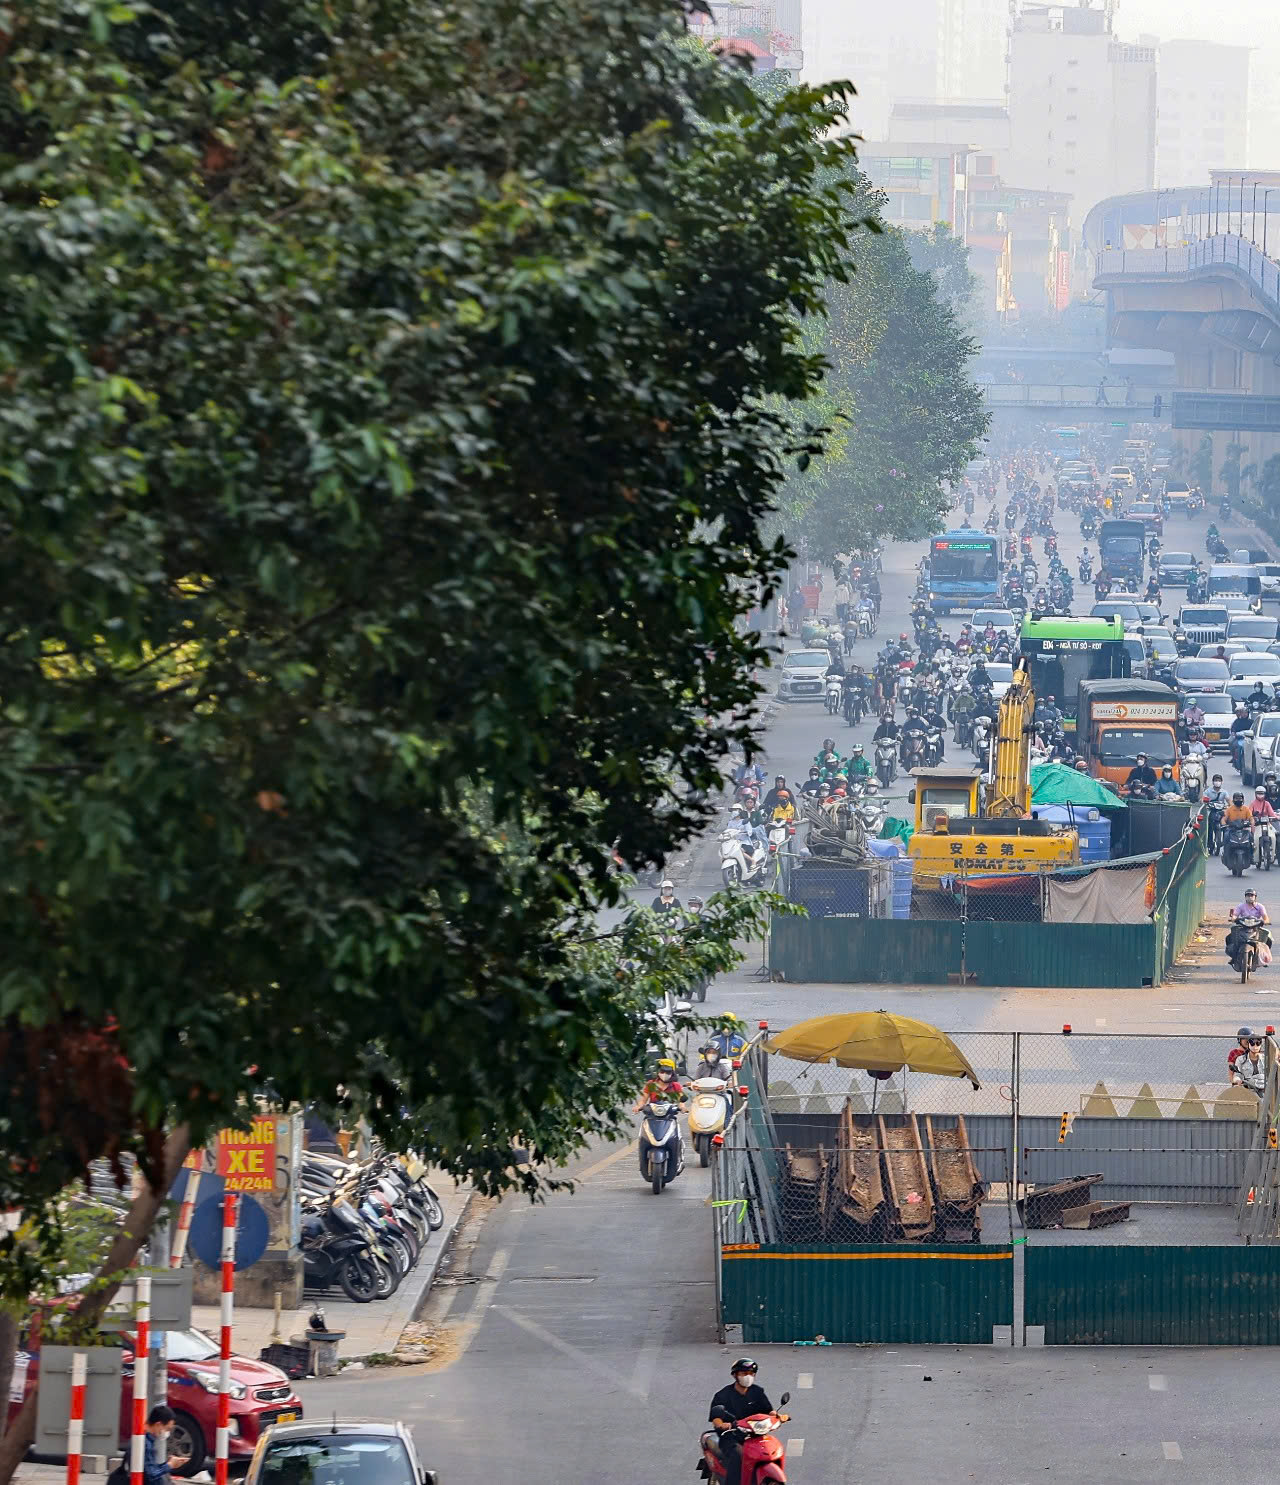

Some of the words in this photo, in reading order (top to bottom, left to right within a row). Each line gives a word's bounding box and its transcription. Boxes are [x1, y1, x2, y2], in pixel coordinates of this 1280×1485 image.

[950, 842, 1035, 856] 安全第一
[226, 1149, 265, 1173] XE
